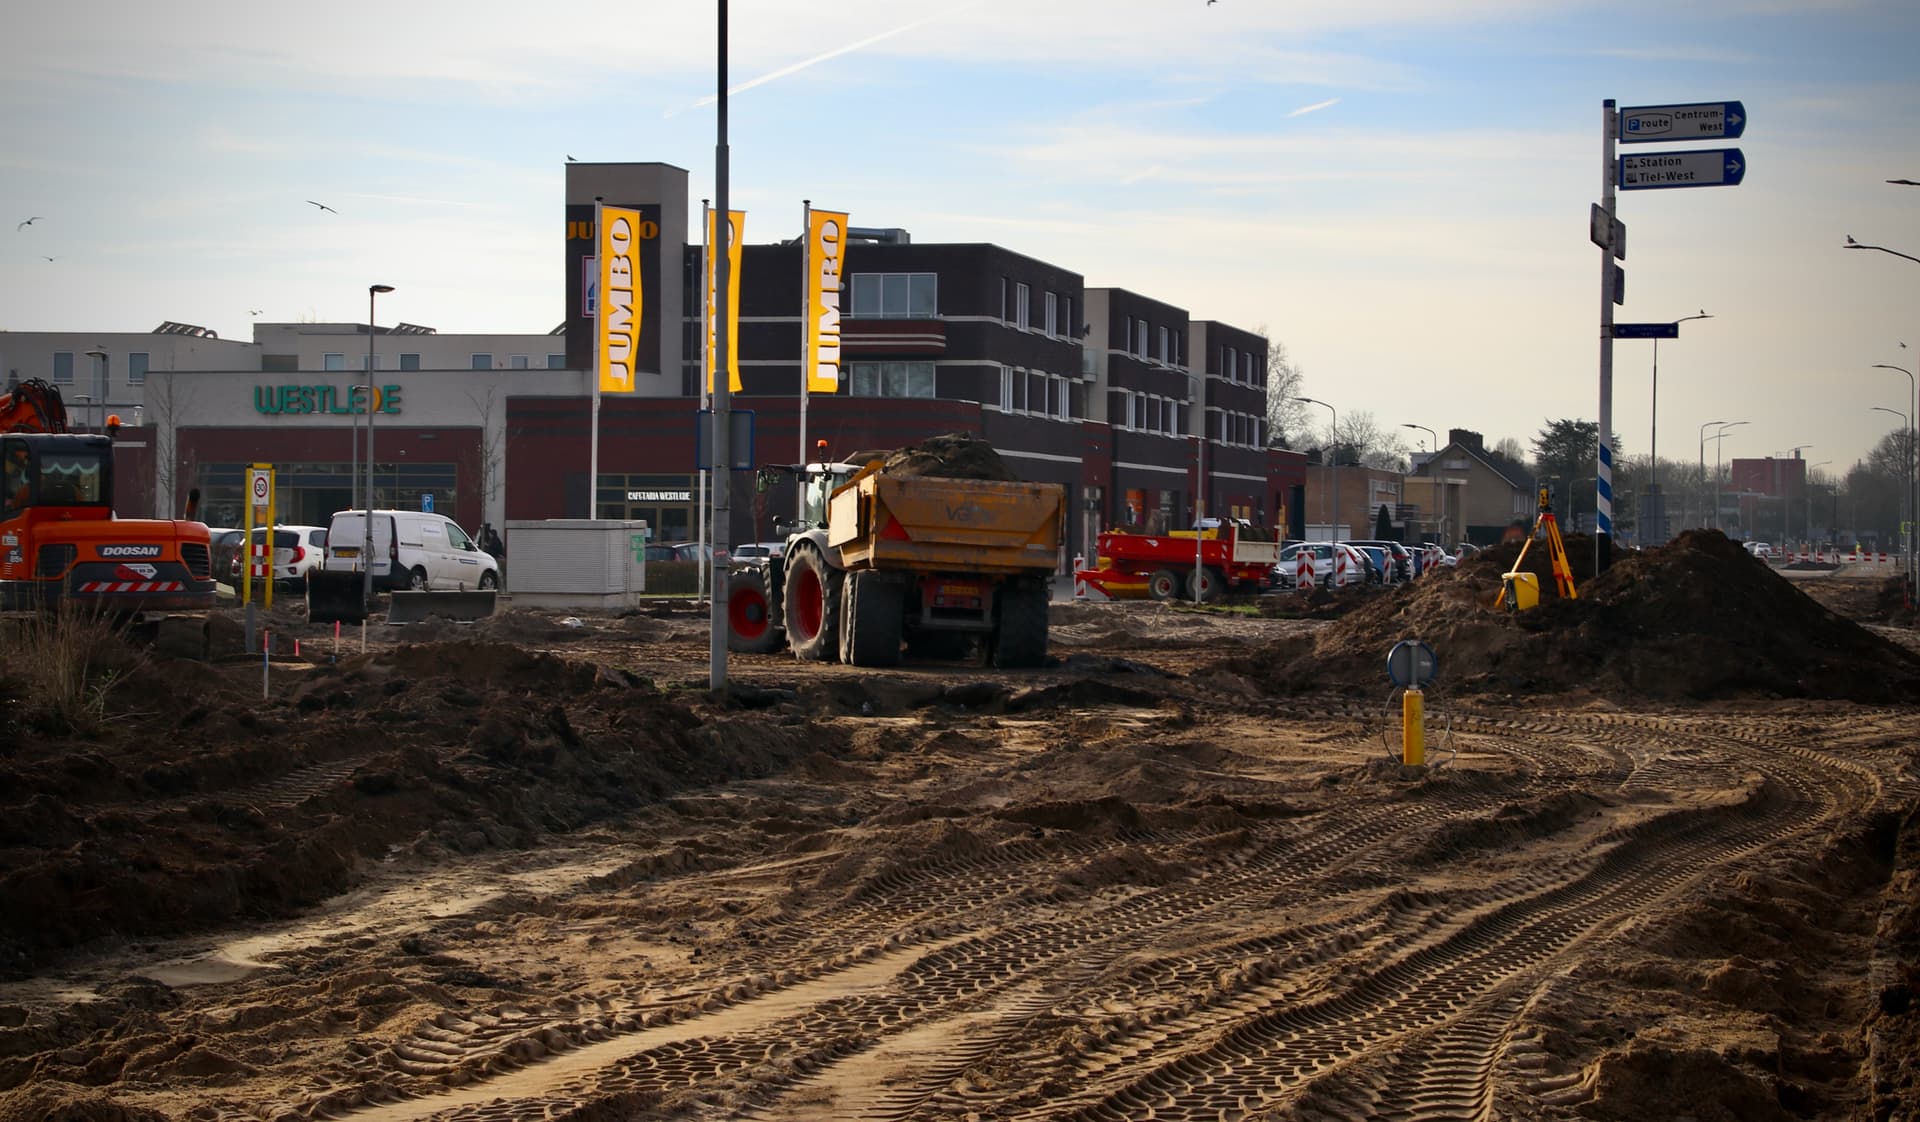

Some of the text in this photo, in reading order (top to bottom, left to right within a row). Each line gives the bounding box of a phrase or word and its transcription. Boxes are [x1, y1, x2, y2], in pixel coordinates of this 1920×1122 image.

[1674, 110, 1723, 120] Centrum-
[1641, 118, 1669, 128] route
[1699, 122, 1723, 132] West
[1639, 157, 1682, 168] Station
[1639, 171, 1695, 183] Tiel-West
[567, 220, 659, 240] JUO
[608, 216, 634, 386] JUMBO
[256, 483, 266, 492] 30
[102, 546, 160, 556] DOOSAN
